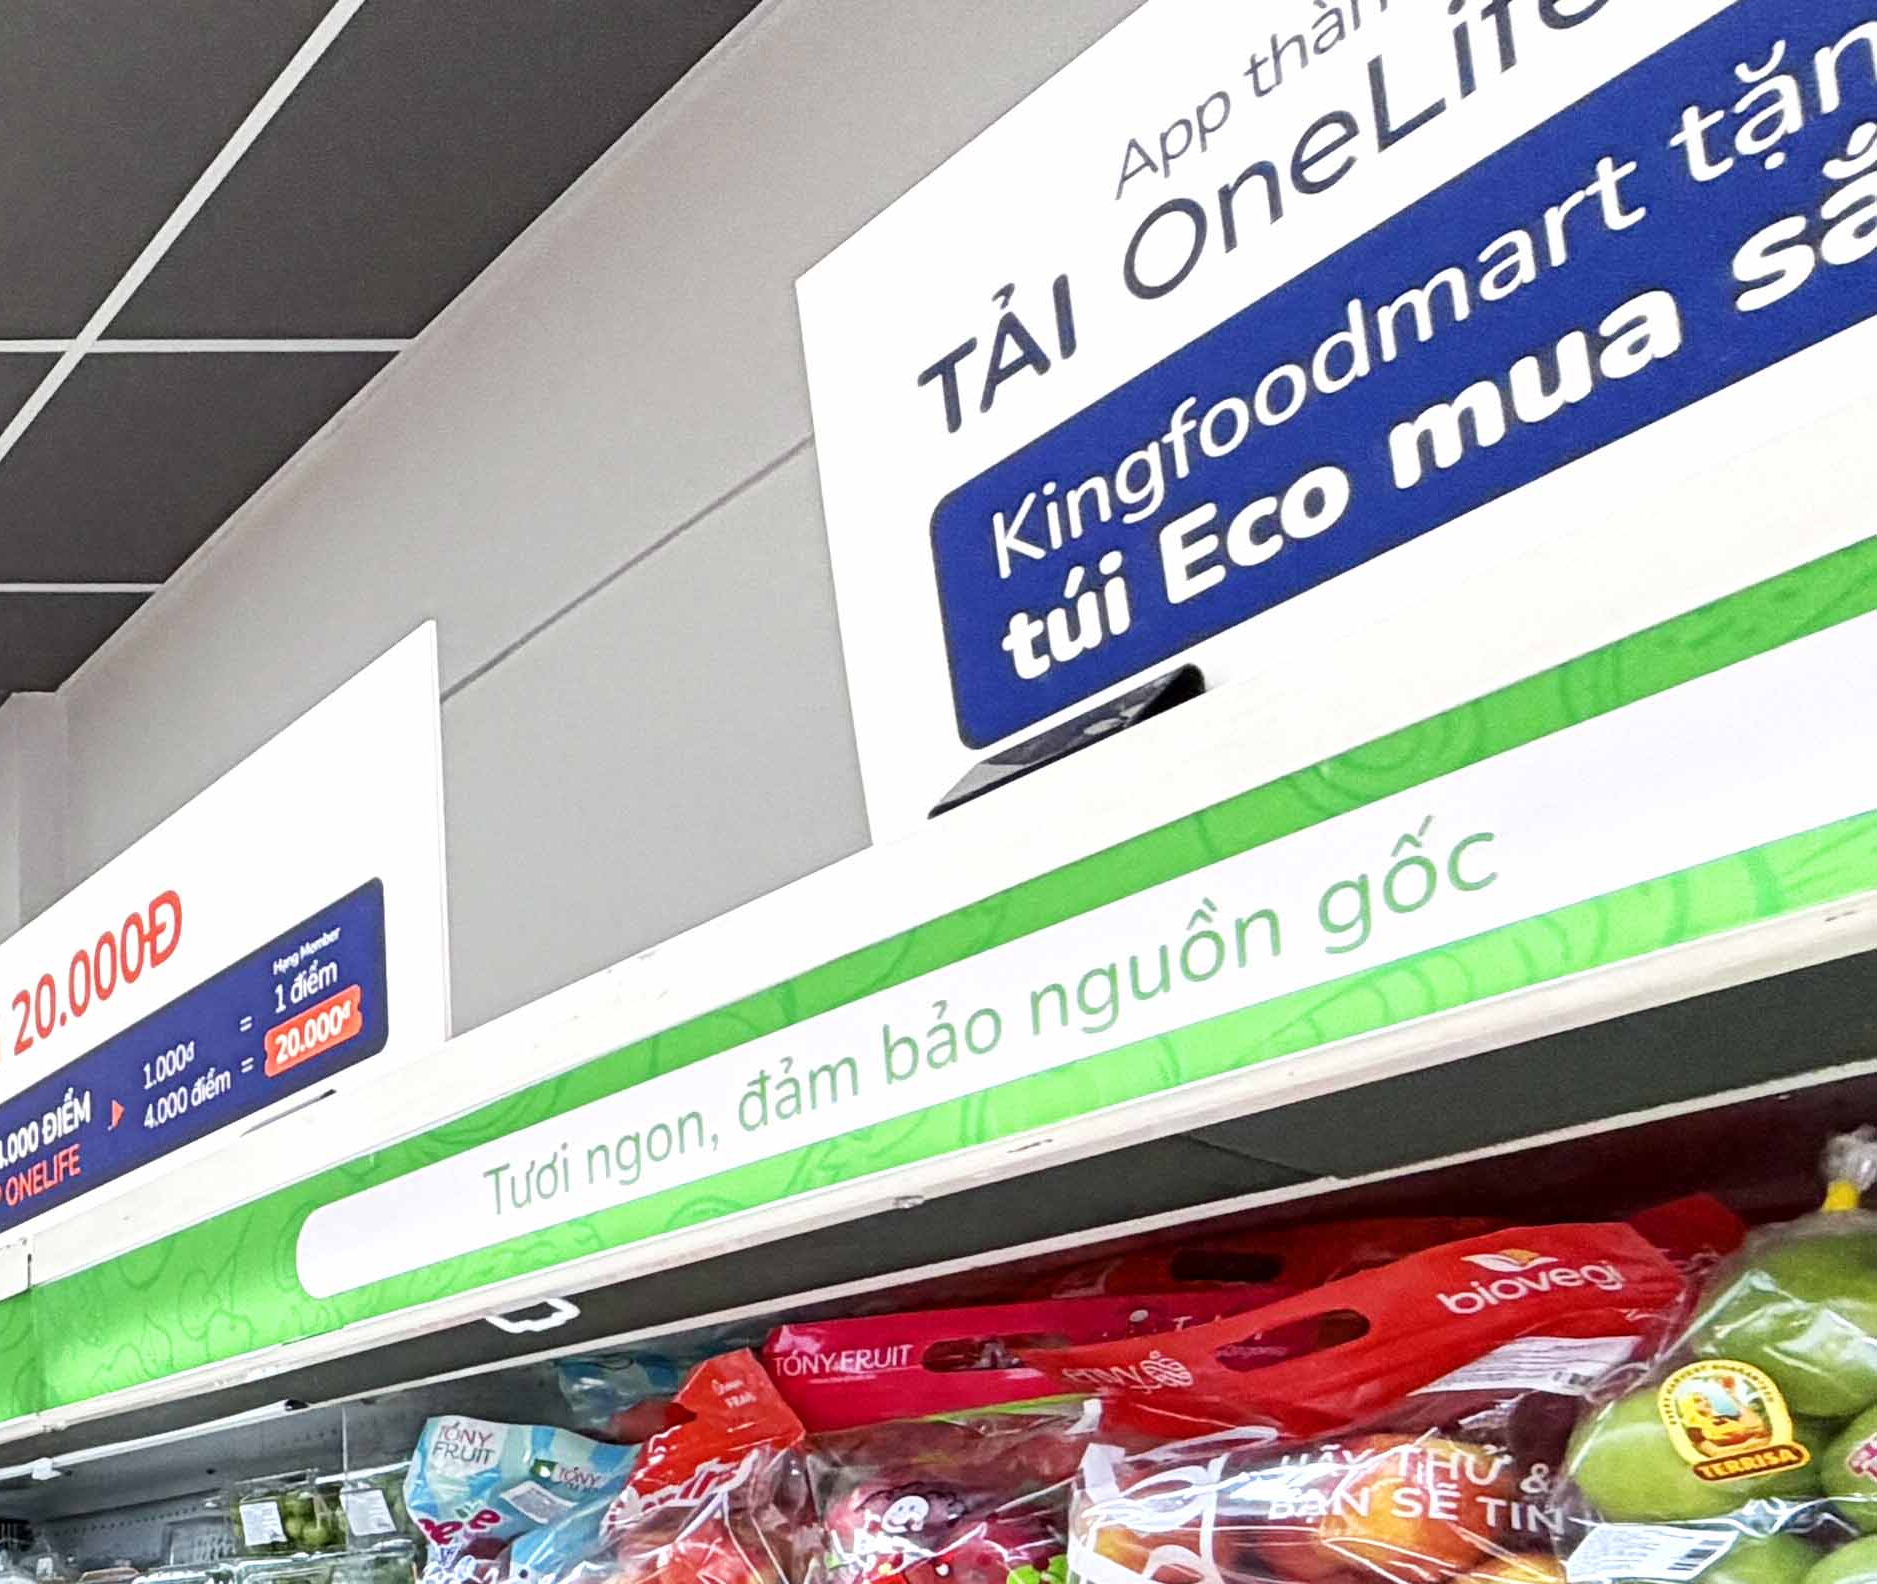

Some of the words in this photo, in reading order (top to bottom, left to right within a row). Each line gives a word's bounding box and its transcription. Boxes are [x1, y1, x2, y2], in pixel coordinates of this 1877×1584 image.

[1114, 86, 1233, 200] App
[916, 270, 1080, 436] TẢI
[992, 154, 1648, 581] Kingfoodmart
[999, 564, 1136, 681] túi
[1158, 463, 1352, 606] Eco
[1387, 286, 1684, 492] mua
[11, 888, 183, 1057] 20.000Đ
[299, 926, 342, 959] Member
[143, 1040, 196, 1091] 1.000đ
[274, 983, 288, 1014] 1
[289, 958, 339, 1005] điểm
[143, 1085, 189, 1130] 4.000
[190, 1066, 232, 1107] điểm
[274, 998, 353, 1066] 20.000đ
[482, 1142, 573, 1218] Tươi
[584, 1110, 722, 1190] ngon,
[735, 1054, 862, 1133] đảm
[881, 998, 1004, 1087] bảo
[1027, 897, 1283, 1039] nguồn
[1314, 813, 1501, 940] gốc
[41, 1086, 93, 1146] ĐIỂM
[4, 1142, 82, 1208] ONELIFE
[1435, 1258, 1626, 1316] biovegi
[836, 1343, 913, 1373] FRUIT
[431, 1442, 496, 1466] FRUIT
[1696, 1448, 1799, 1480] TERRISA
